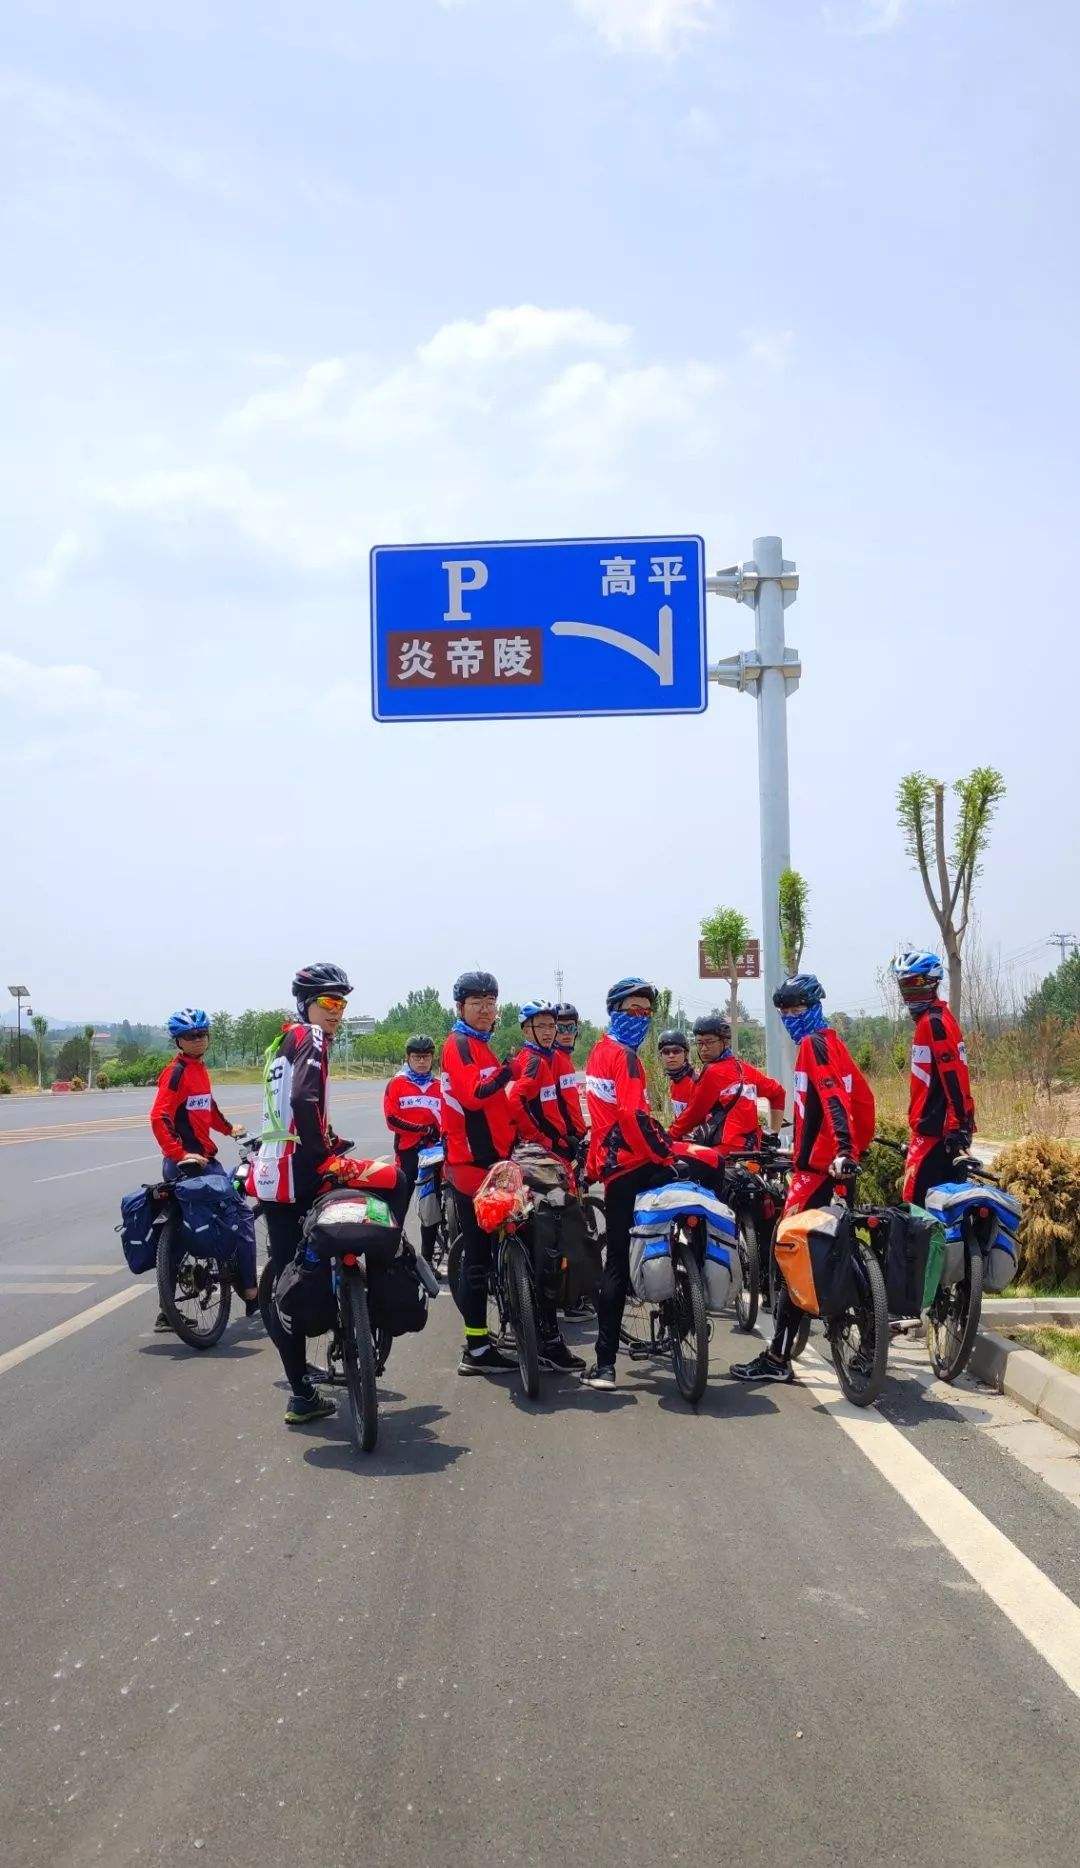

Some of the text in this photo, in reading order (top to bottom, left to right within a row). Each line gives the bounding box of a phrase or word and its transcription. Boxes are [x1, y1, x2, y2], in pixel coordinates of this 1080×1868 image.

[441, 560, 488, 621] P
[600, 556, 687, 596] 高平
[398, 635, 532, 680] 炎帝陵
